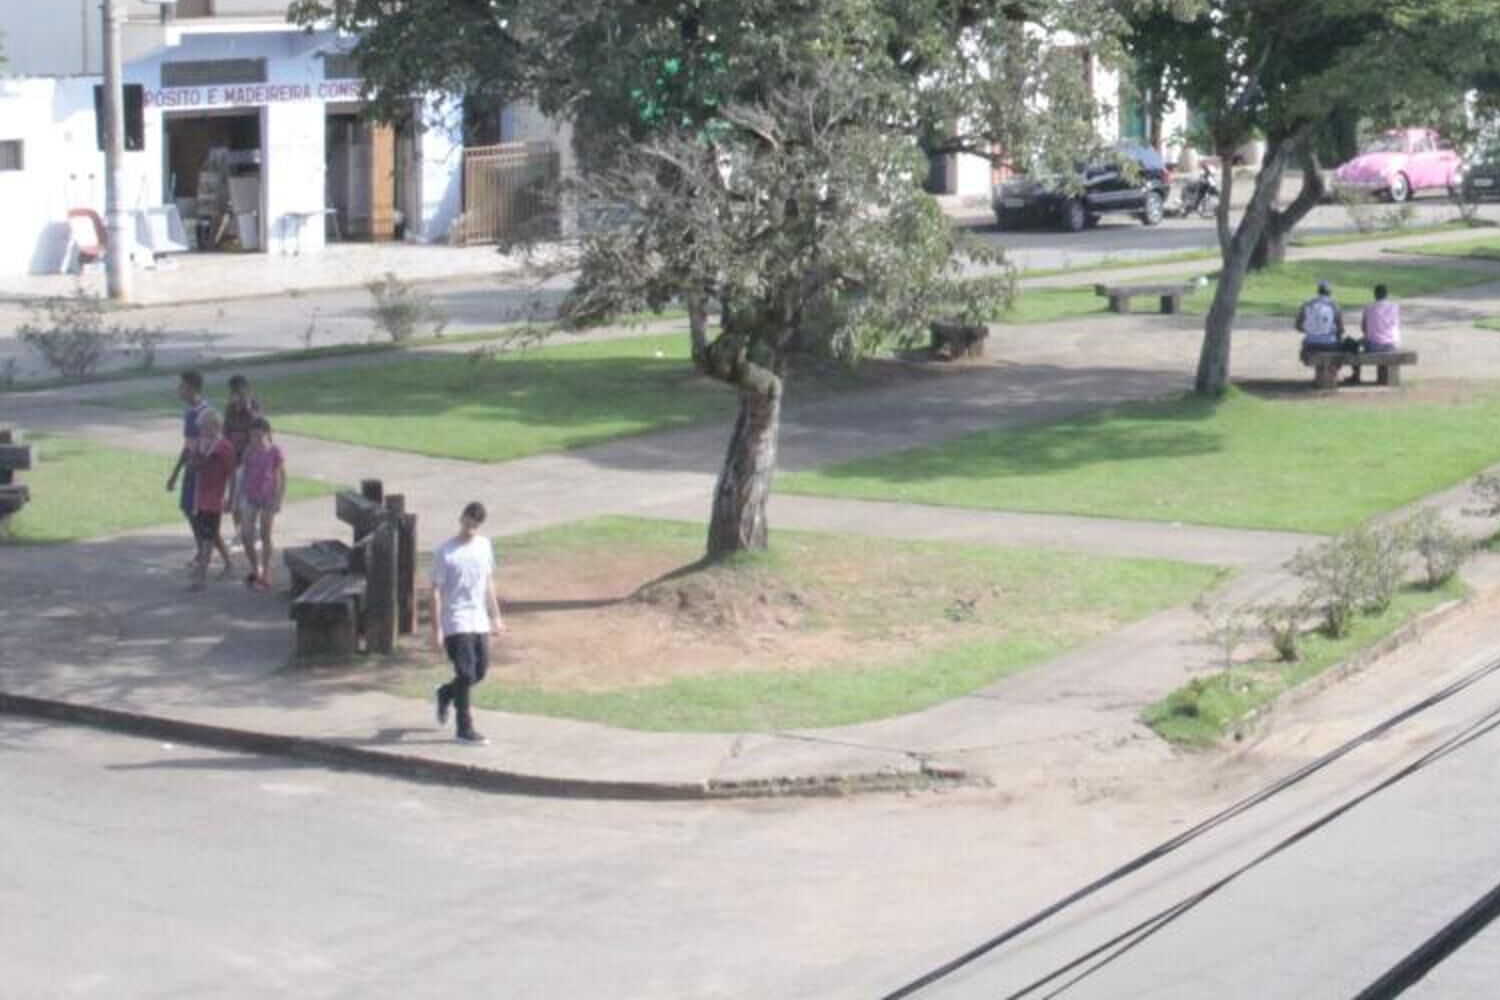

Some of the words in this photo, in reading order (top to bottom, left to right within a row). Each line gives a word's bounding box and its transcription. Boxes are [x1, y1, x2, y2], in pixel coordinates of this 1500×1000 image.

[143, 89, 199, 108] POSITO
[206, 88, 218, 106] E
[223, 84, 311, 104] MADEIREIRA
[318, 81, 359, 100] CONS
